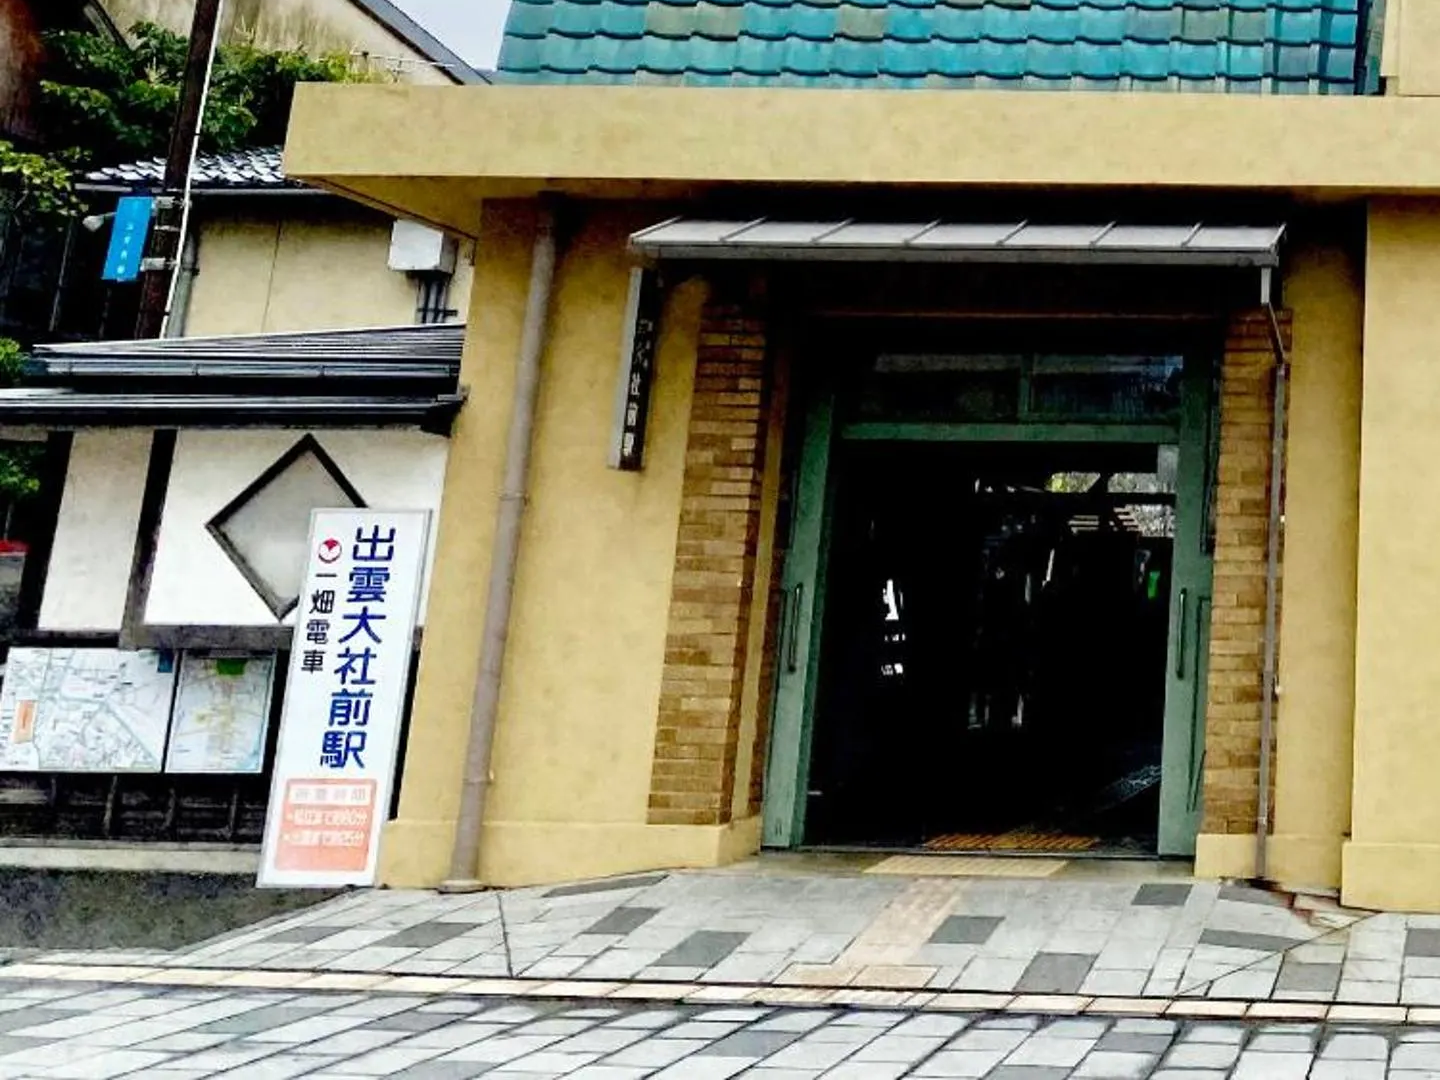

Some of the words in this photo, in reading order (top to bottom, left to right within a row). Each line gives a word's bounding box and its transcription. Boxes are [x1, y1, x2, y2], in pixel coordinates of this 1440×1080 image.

[301, 573, 338, 675] 一畑電車
[319, 524, 396, 769] 出雲大社前駅
